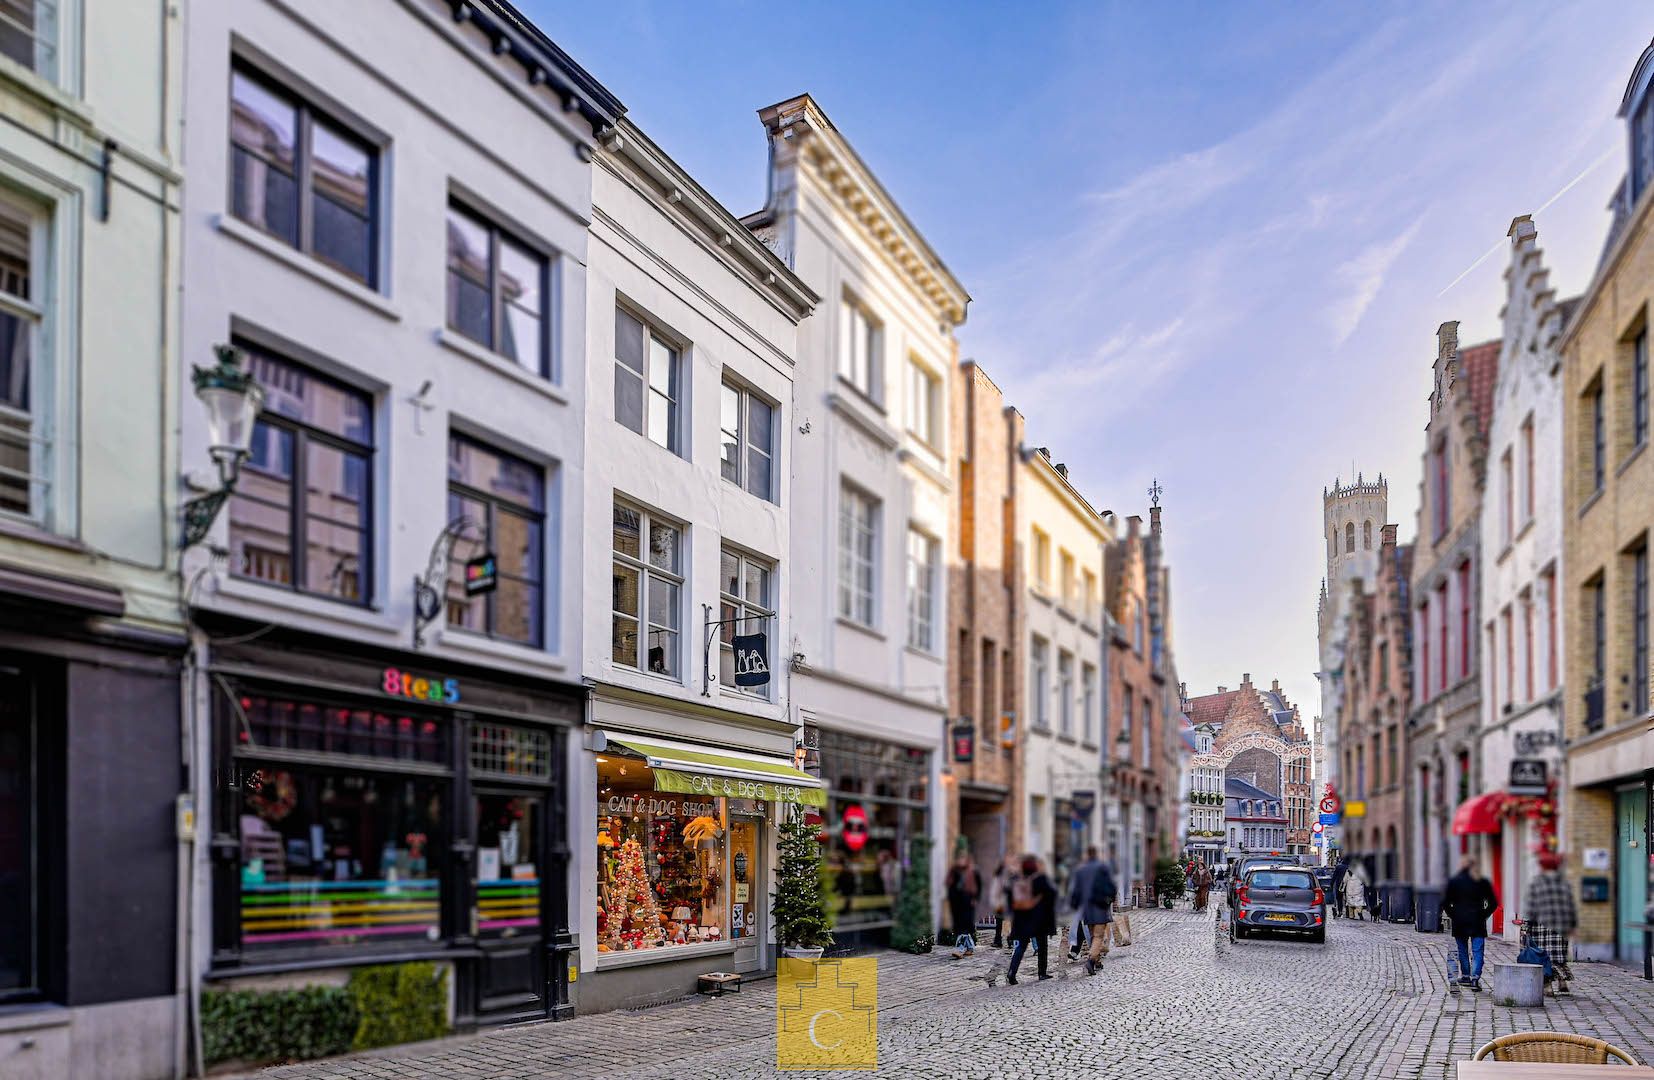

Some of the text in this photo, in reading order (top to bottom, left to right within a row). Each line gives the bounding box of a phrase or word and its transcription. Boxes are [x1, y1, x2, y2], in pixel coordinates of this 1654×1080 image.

[384, 667, 462, 704] 8tea5
[692, 776, 800, 801] CAT & DOG SHOP
[608, 795, 714, 817] CAT & DOG SHOP
